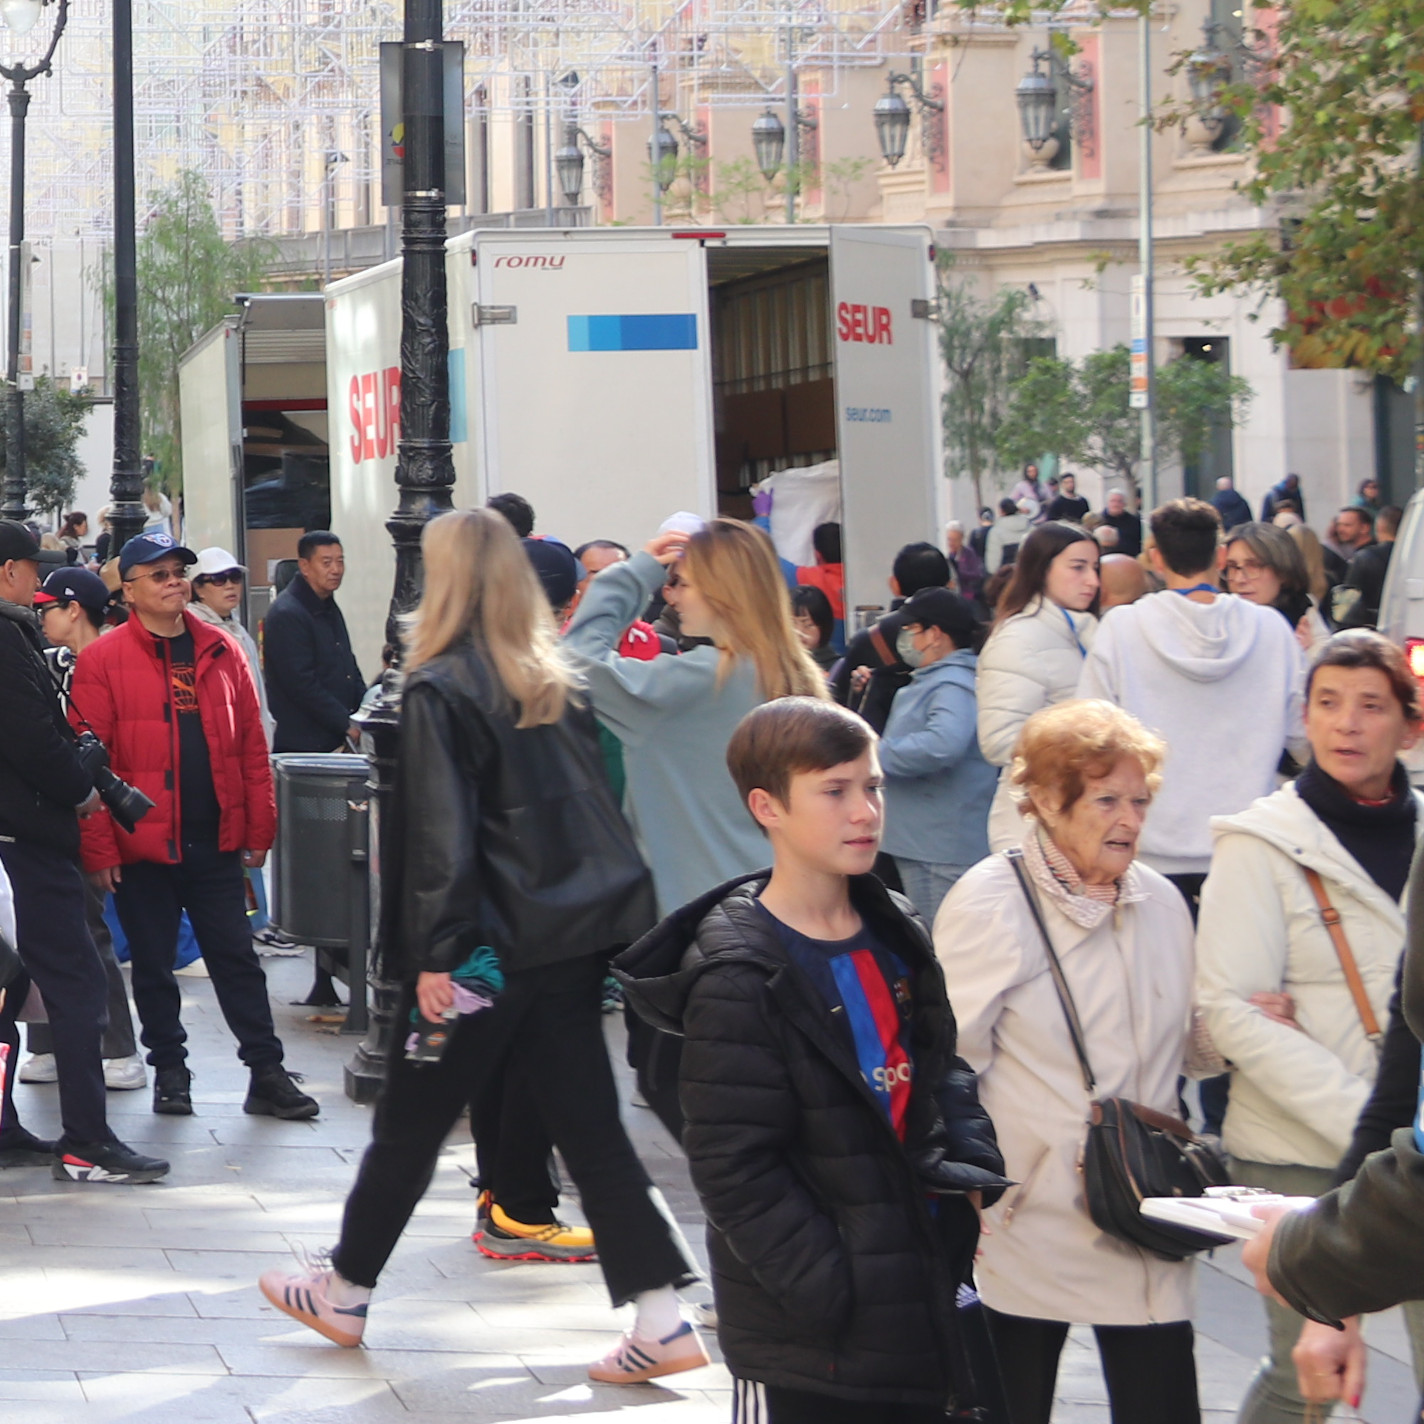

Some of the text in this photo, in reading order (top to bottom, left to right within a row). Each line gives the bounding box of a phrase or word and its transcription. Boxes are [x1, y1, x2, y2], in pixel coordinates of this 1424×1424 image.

[493, 255, 566, 269] romu
[837, 301, 893, 345] SEUR
[845, 406, 893, 424] seur.com
